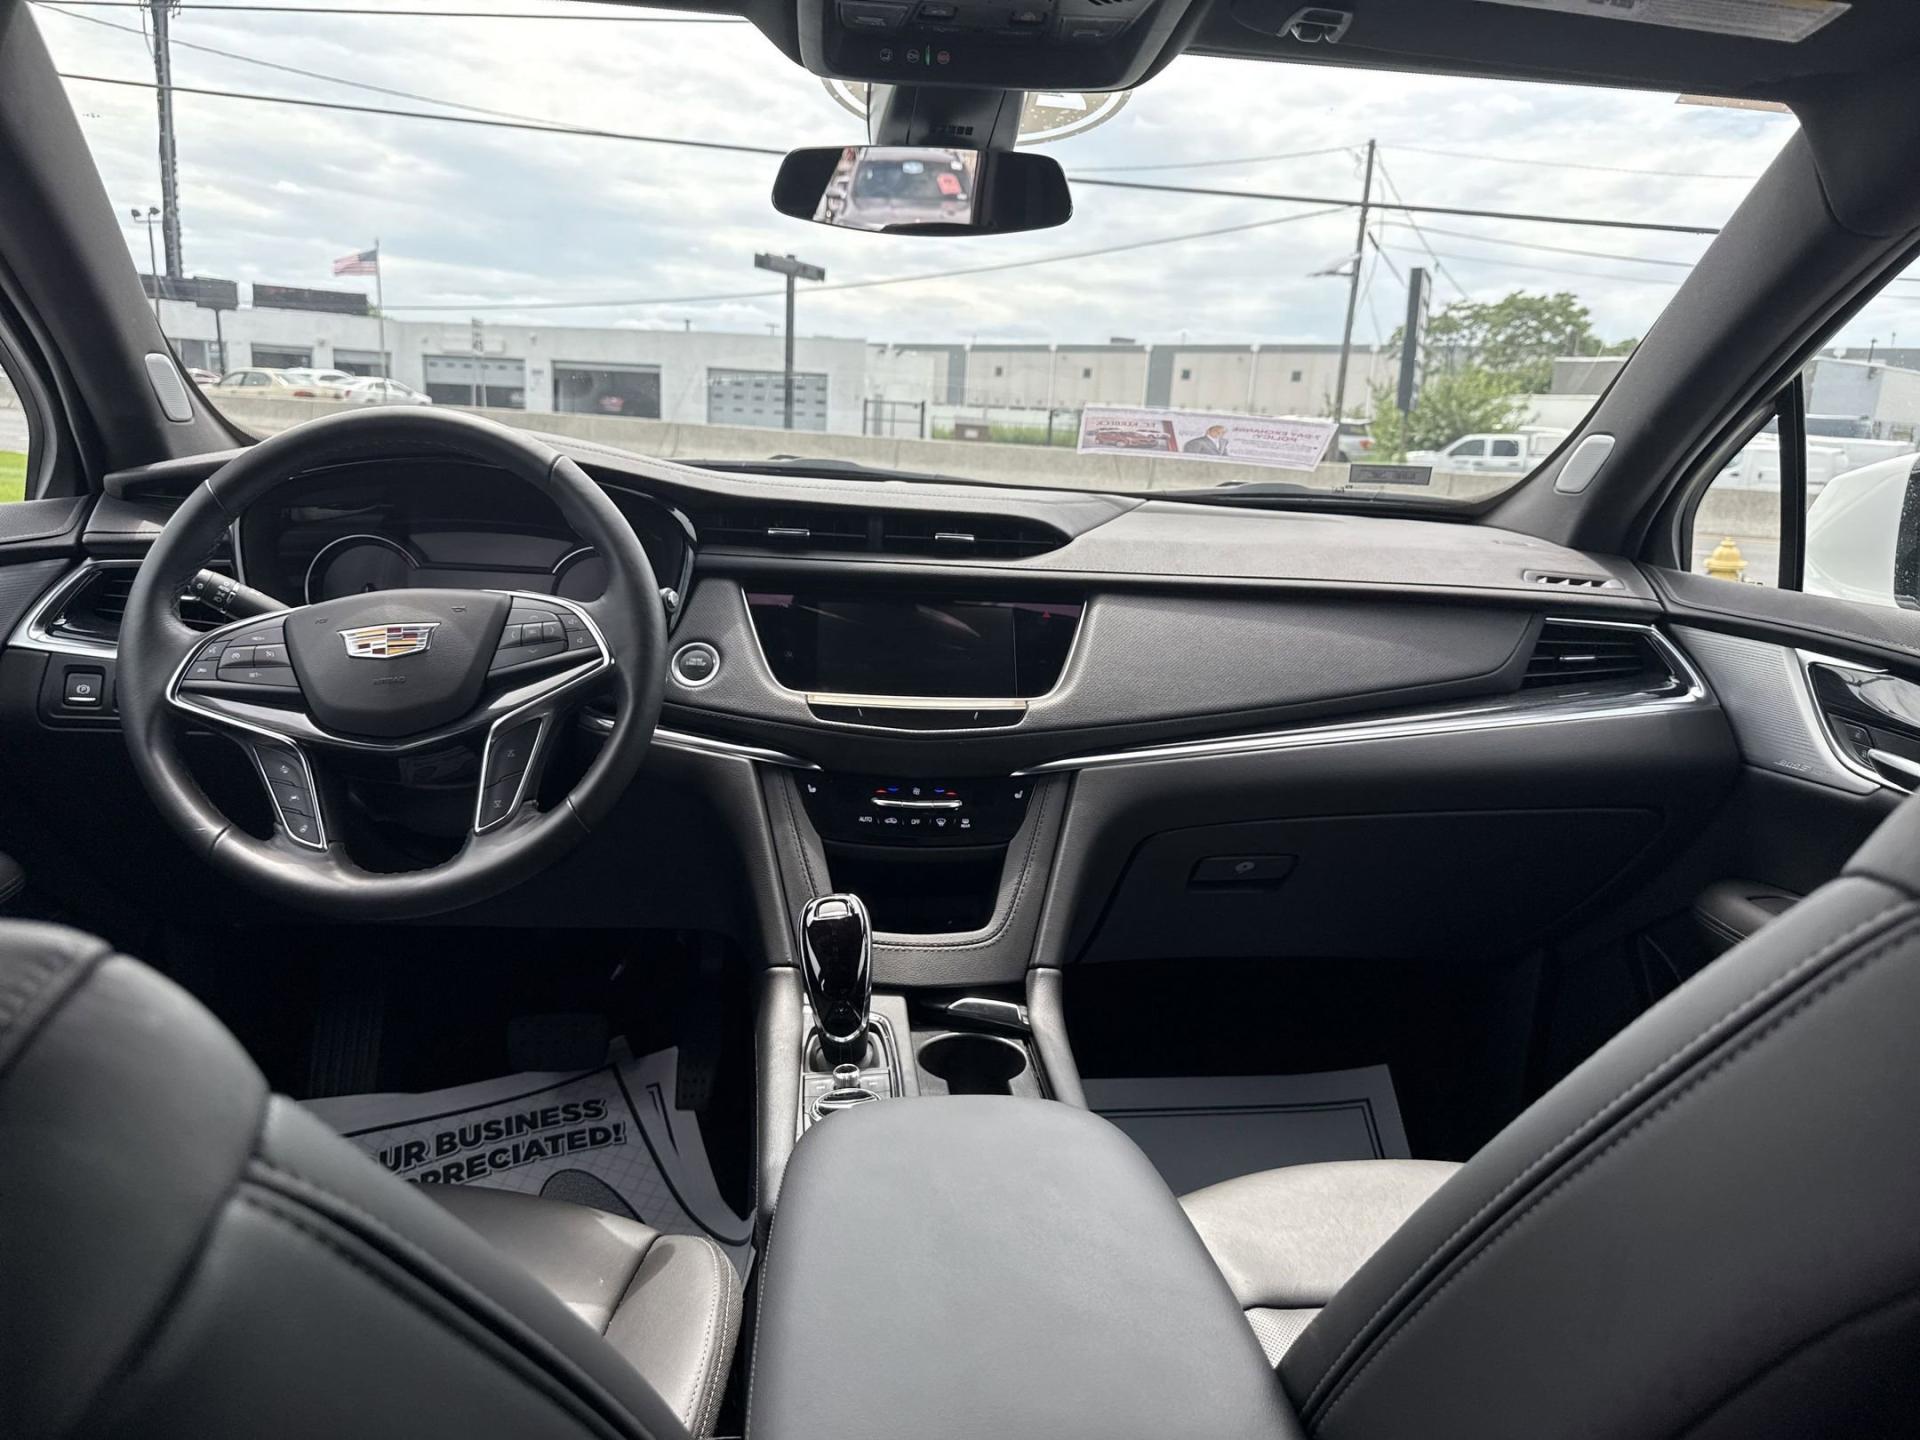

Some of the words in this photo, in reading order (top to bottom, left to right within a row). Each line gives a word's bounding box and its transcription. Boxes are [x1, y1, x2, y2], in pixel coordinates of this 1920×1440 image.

[379, 1139, 427, 1172] UR
[435, 1099, 608, 1158] BUSINESS
[402, 1121, 627, 1184] PRECIATED!
